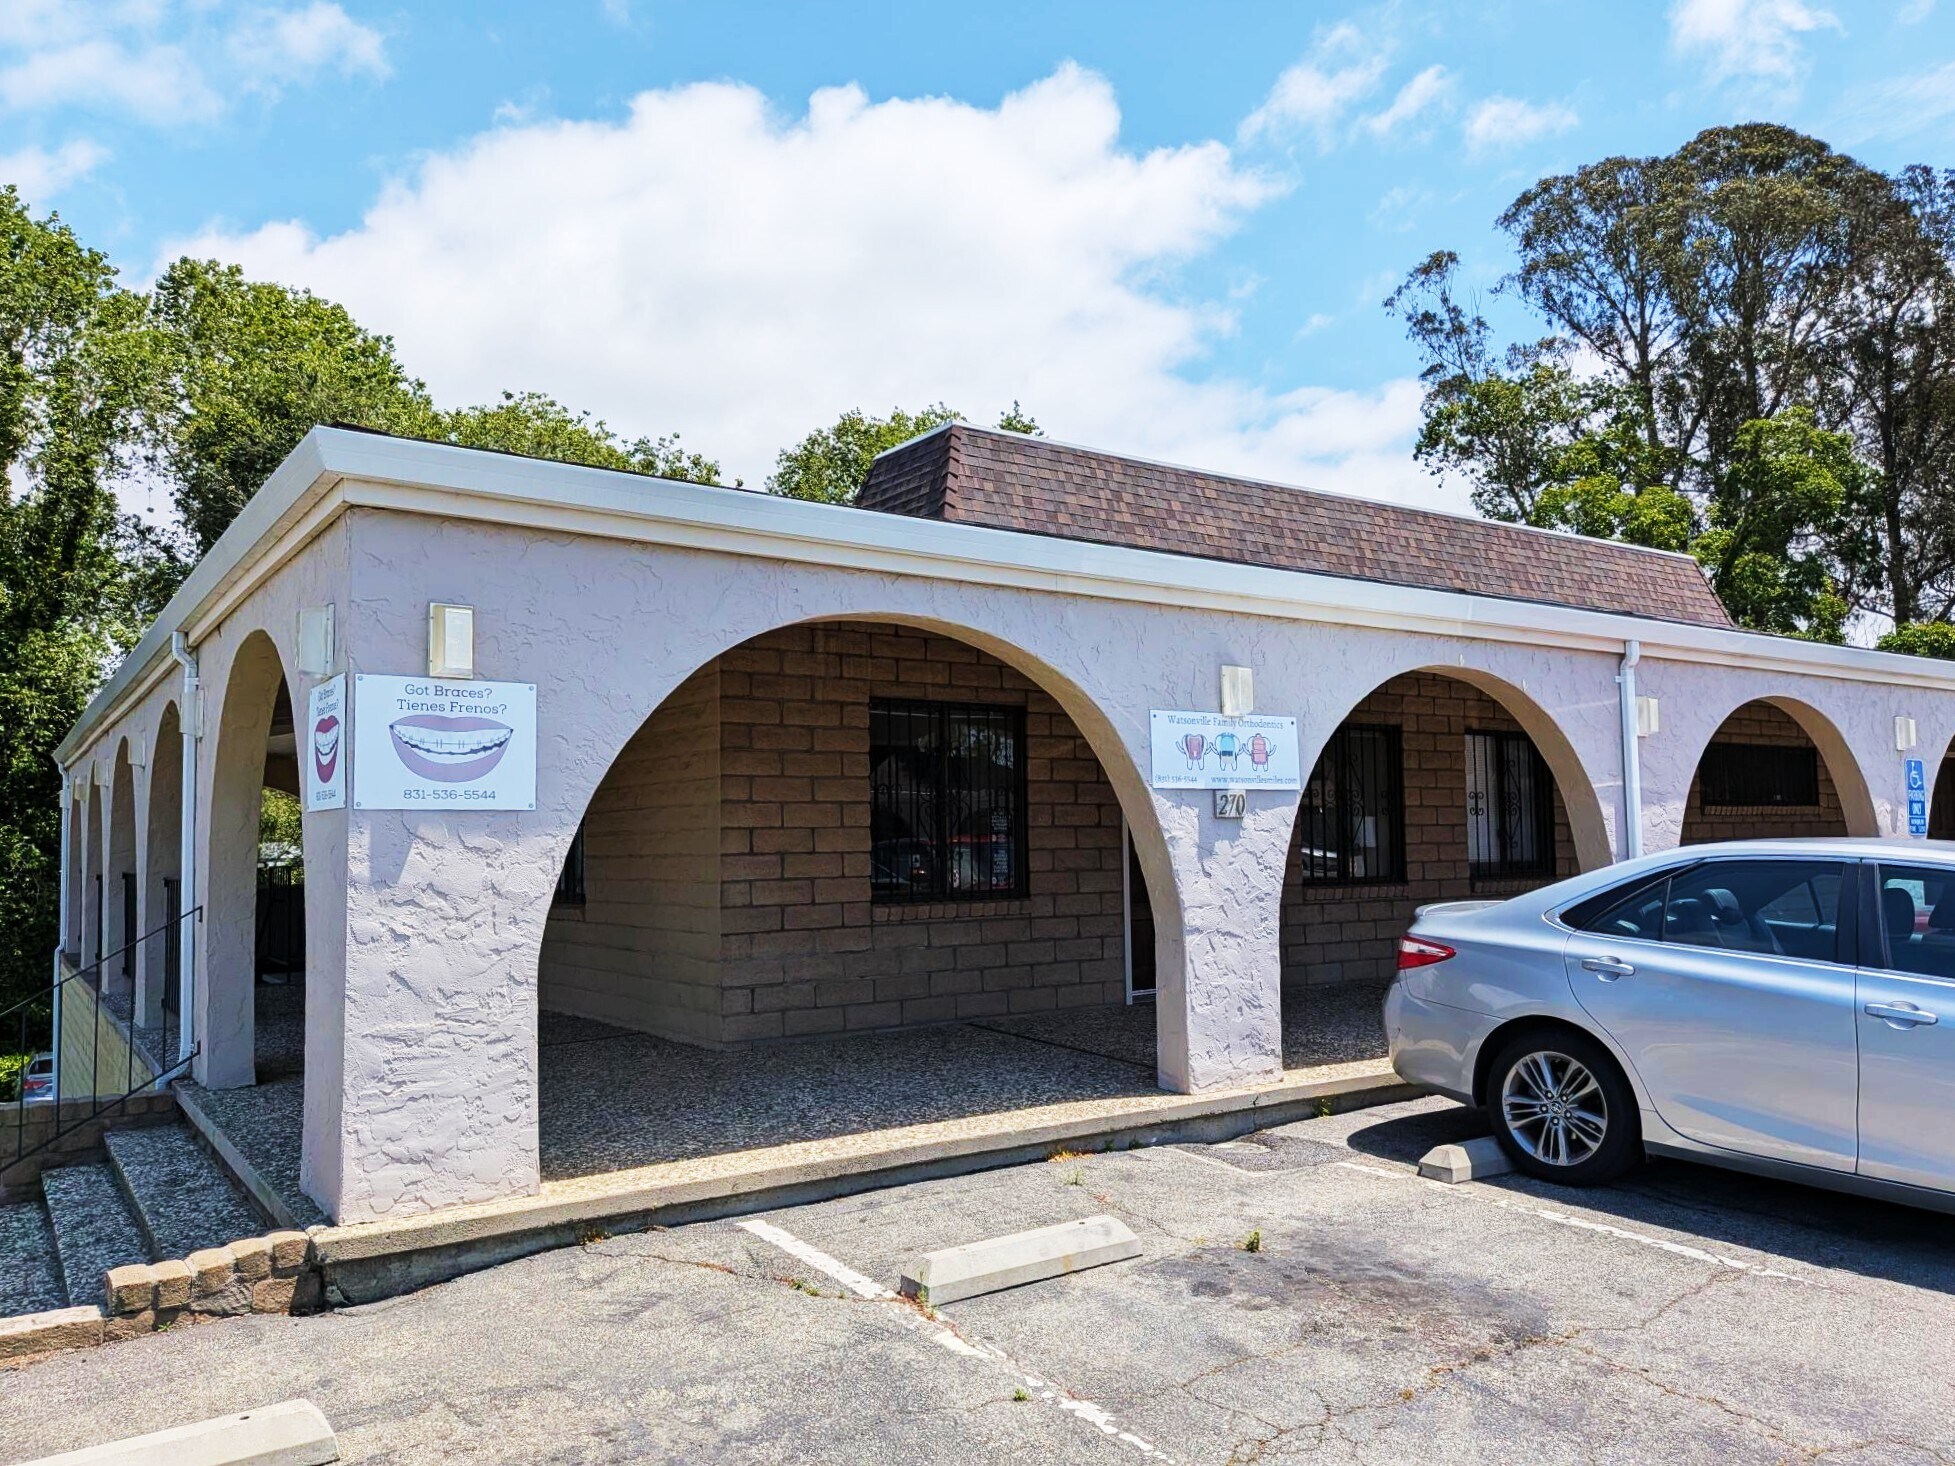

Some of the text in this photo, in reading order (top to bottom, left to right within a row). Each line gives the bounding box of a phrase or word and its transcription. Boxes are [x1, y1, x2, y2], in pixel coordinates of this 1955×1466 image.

[404, 683, 493, 699] Got Braces?
[396, 699, 508, 715] Tienes Frenos?
[1167, 714, 1212, 726] Watsonville
[1213, 717, 1237, 729] Family
[403, 789, 497, 801] 831-536-5544
[1219, 793, 1246, 816] 270
